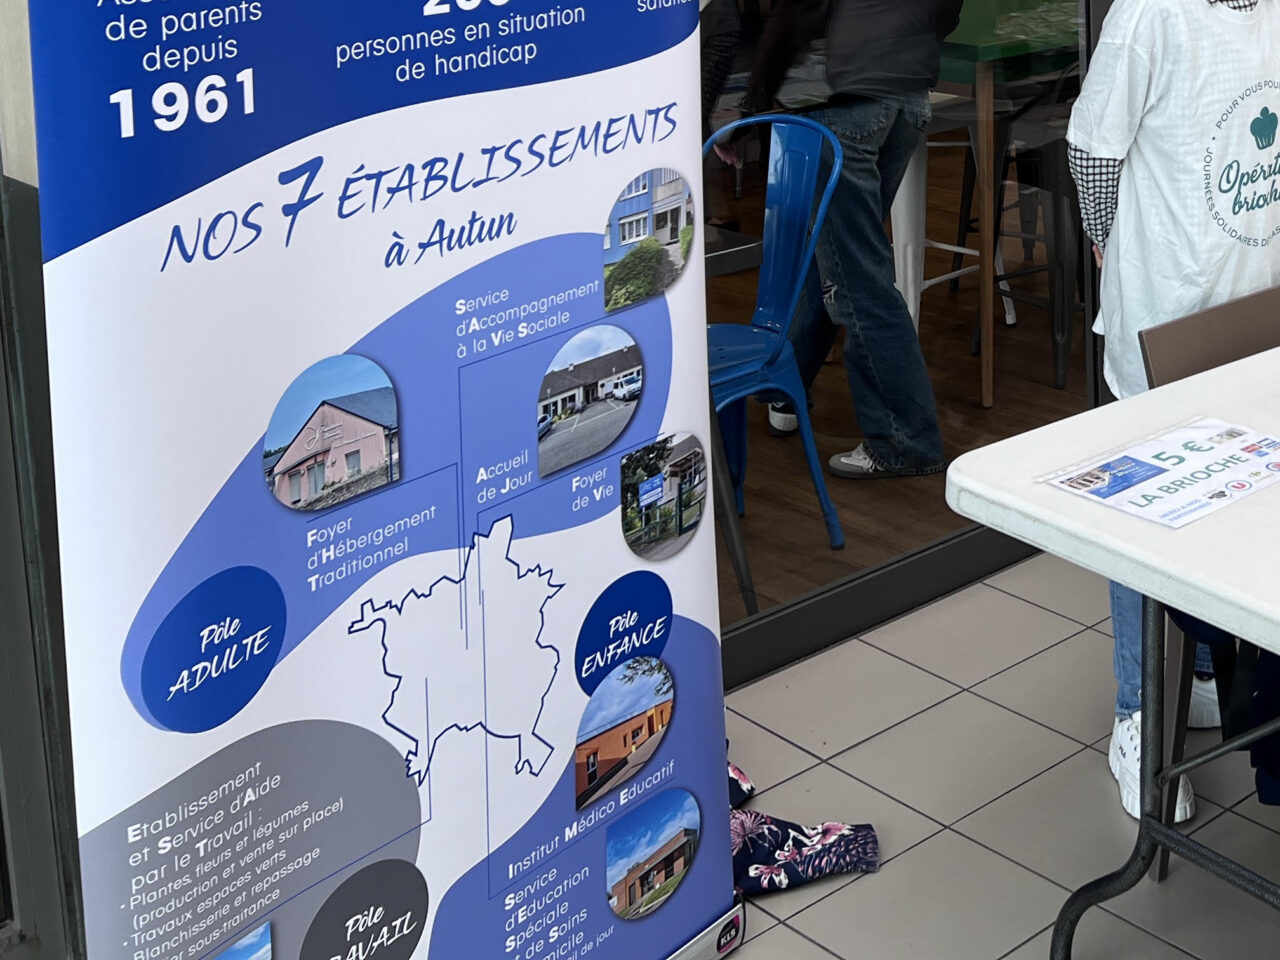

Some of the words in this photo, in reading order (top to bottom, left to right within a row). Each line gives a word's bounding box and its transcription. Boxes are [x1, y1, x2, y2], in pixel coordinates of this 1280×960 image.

[105, 11, 153, 42] de
[161, 1, 262, 45] parents
[335, 24, 456, 68] personnes
[464, 19, 491, 43] en
[498, 3, 585, 37] situation
[142, 36, 238, 74] depuis
[396, 57, 426, 82] de
[434, 41, 537, 78] handicap
[108, 68, 256, 138] 1961
[1216, 99, 1240, 129] POUR
[1239, 81, 1263, 101] VOUS
[159, 202, 263, 273] NOS
[277, 155, 324, 248] 7
[337, 102, 678, 220] ÉTABLISSEMENTS
[384, 230, 409, 268] à
[414, 208, 518, 265] Autun
[455, 287, 509, 317] Service
[456, 277, 600, 337] d'Accompagnement
[473, 334, 487, 355] la
[490, 326, 514, 348] Vie
[518, 308, 570, 341] Sociale
[476, 449, 529, 485] Accueil
[571, 464, 608, 493] Foyer
[1151, 451, 1187, 467] 5
[1181, 440, 1216, 453] €
[476, 481, 497, 504] de
[501, 468, 534, 494] Jour
[572, 490, 590, 512] de
[593, 480, 614, 504] Vie
[1128, 493, 1164, 508] LA
[1158, 453, 1250, 495] BRIOCHE
[307, 516, 354, 547] Foyer
[307, 504, 438, 571] d'Hébergement
[308, 536, 409, 591] Traditionnel
[199, 615, 241, 655] Pôle
[580, 616, 667, 679] ENFANCE
[608, 608, 639, 638] Pôle
[166, 624, 272, 701] ADULTE
[127, 761, 262, 843] Etablissement
[129, 847, 150, 867] et
[157, 809, 224, 855] Service
[230, 774, 282, 814] d'Aide
[508, 836, 560, 879] Institut
[564, 800, 615, 843] Médico
[619, 759, 675, 807] Educatif
[131, 864, 166, 894] par
[174, 854, 191, 873] le
[195, 809, 253, 857] Travail
[133, 875, 219, 930] (production
[239, 839, 275, 868] vente
[278, 824, 299, 844] sur
[303, 797, 344, 833] place)
[196, 848, 232, 876] fleurs
[253, 800, 310, 841] légumes
[251, 846, 320, 897] repassage
[504, 868, 557, 911] Service
[131, 910, 193, 947] Travaux
[197, 873, 252, 915] espaces
[255, 849, 287, 875] verts
[345, 906, 385, 941] Pôle
[505, 865, 589, 932] d'Education
[505, 901, 569, 953] Spéciale
[548, 907, 588, 944] Soins
